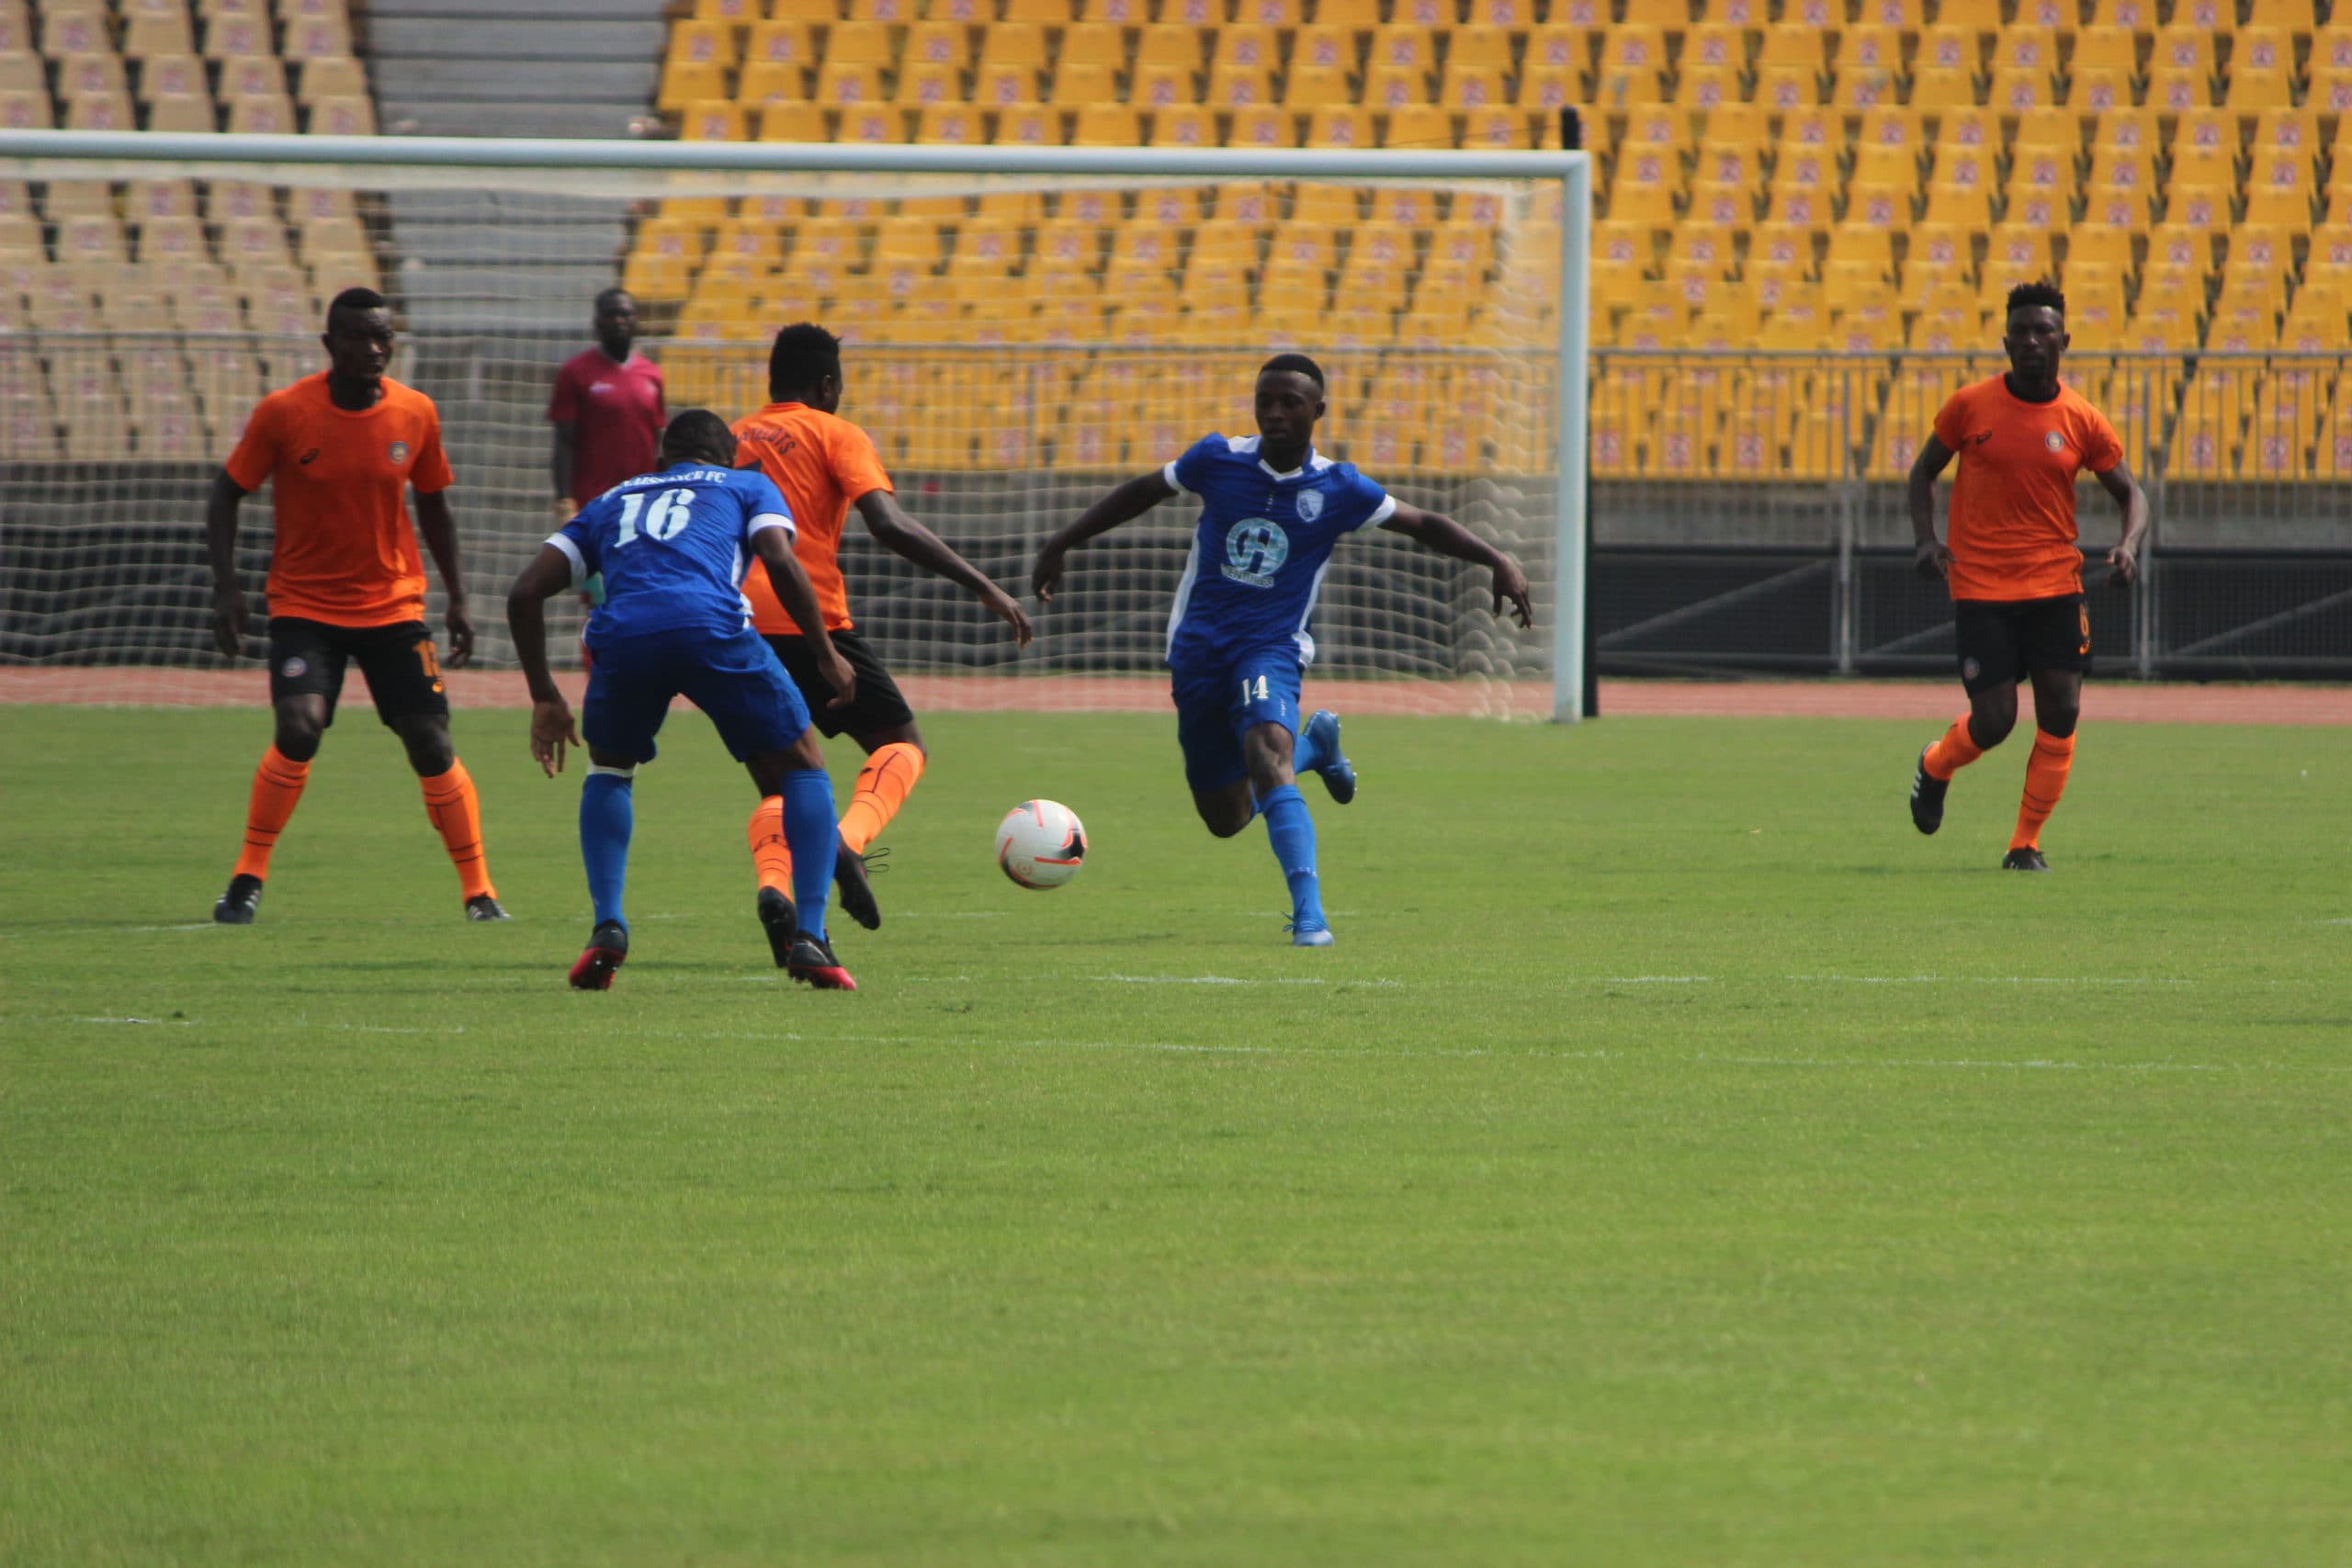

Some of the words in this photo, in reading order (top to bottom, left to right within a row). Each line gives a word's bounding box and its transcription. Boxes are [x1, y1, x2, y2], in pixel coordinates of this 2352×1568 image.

[705, 470, 727, 483] FC
[614, 488, 695, 548] 16
[1242, 674, 1270, 706] 14
